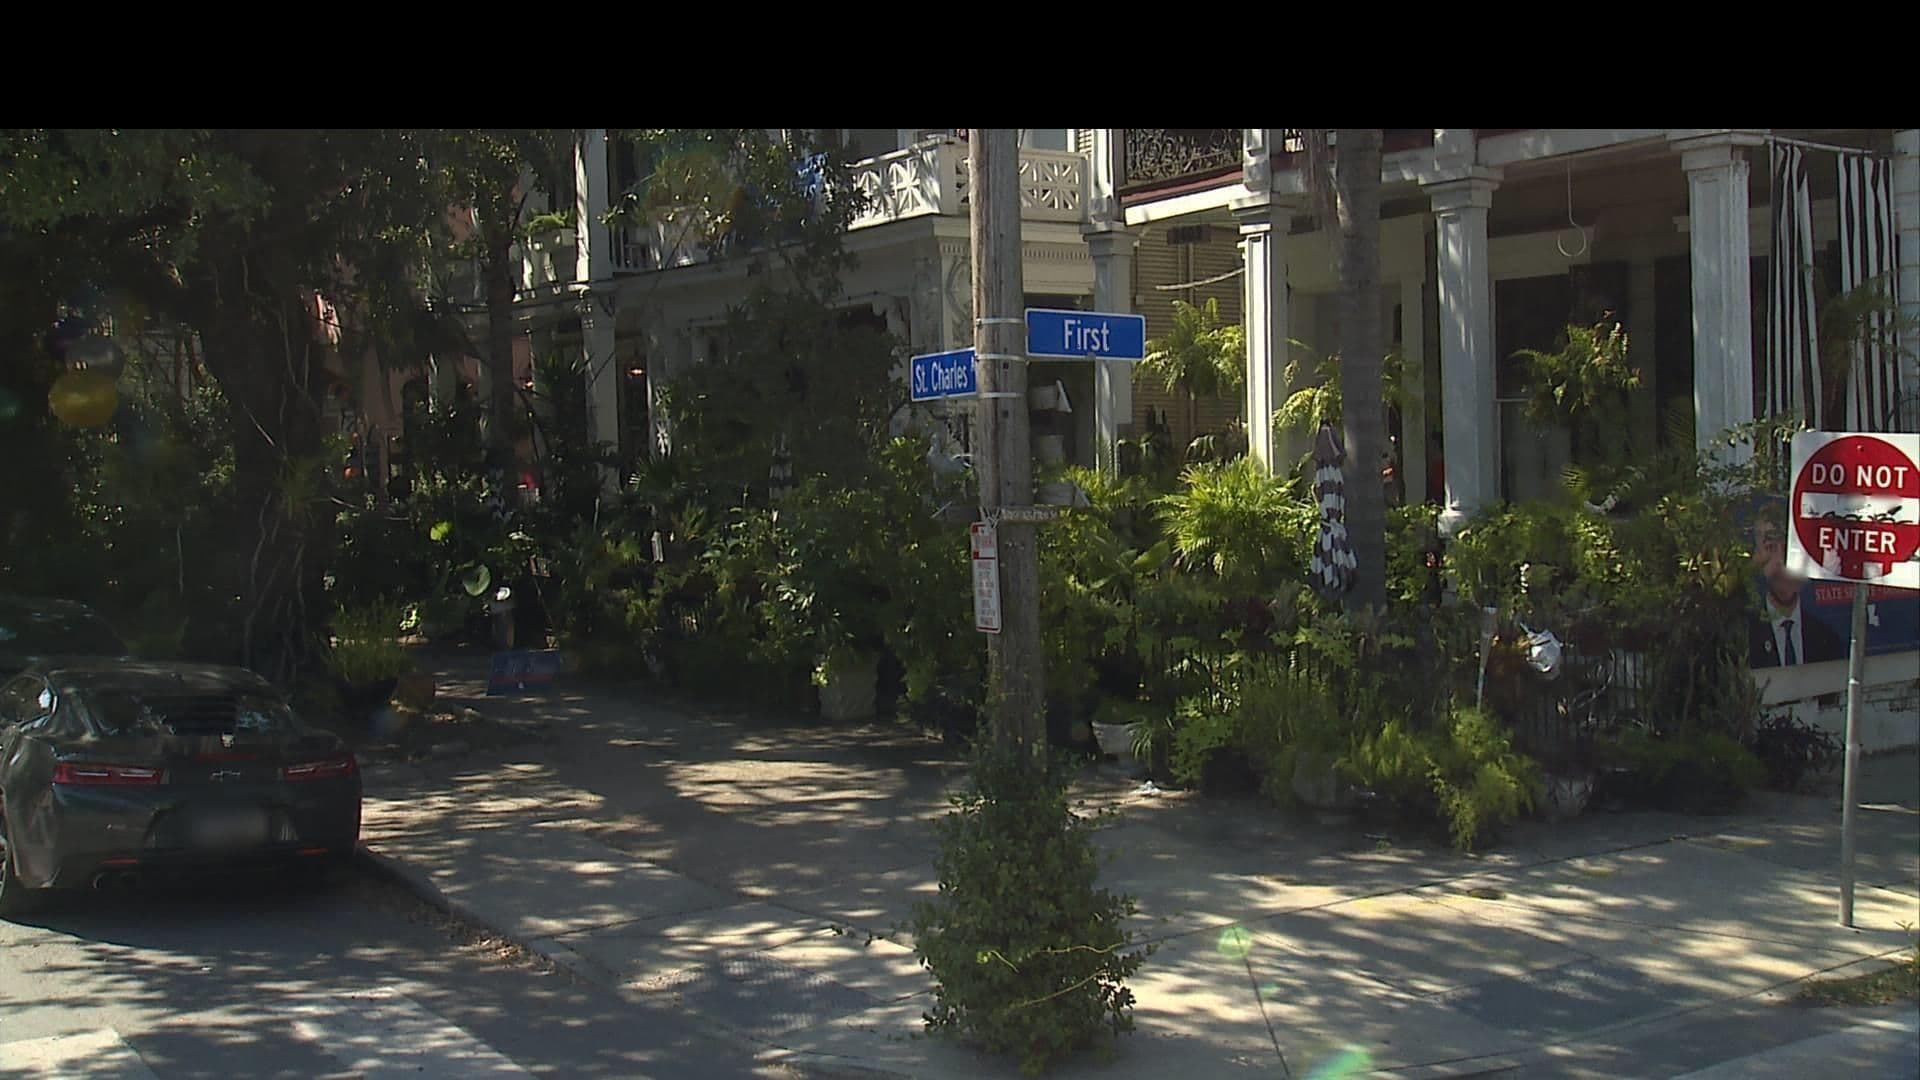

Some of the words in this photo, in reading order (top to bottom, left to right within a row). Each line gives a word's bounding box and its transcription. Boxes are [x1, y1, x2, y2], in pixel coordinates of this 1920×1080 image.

[1064, 319, 1110, 352] First
[915, 364, 928, 393] St.
[931, 360, 968, 391] Charles
[1812, 463, 1845, 485] DO
[1856, 465, 1908, 489] NOT
[1819, 527, 1896, 554] ENTER
[1815, 585, 1840, 600] STATE
